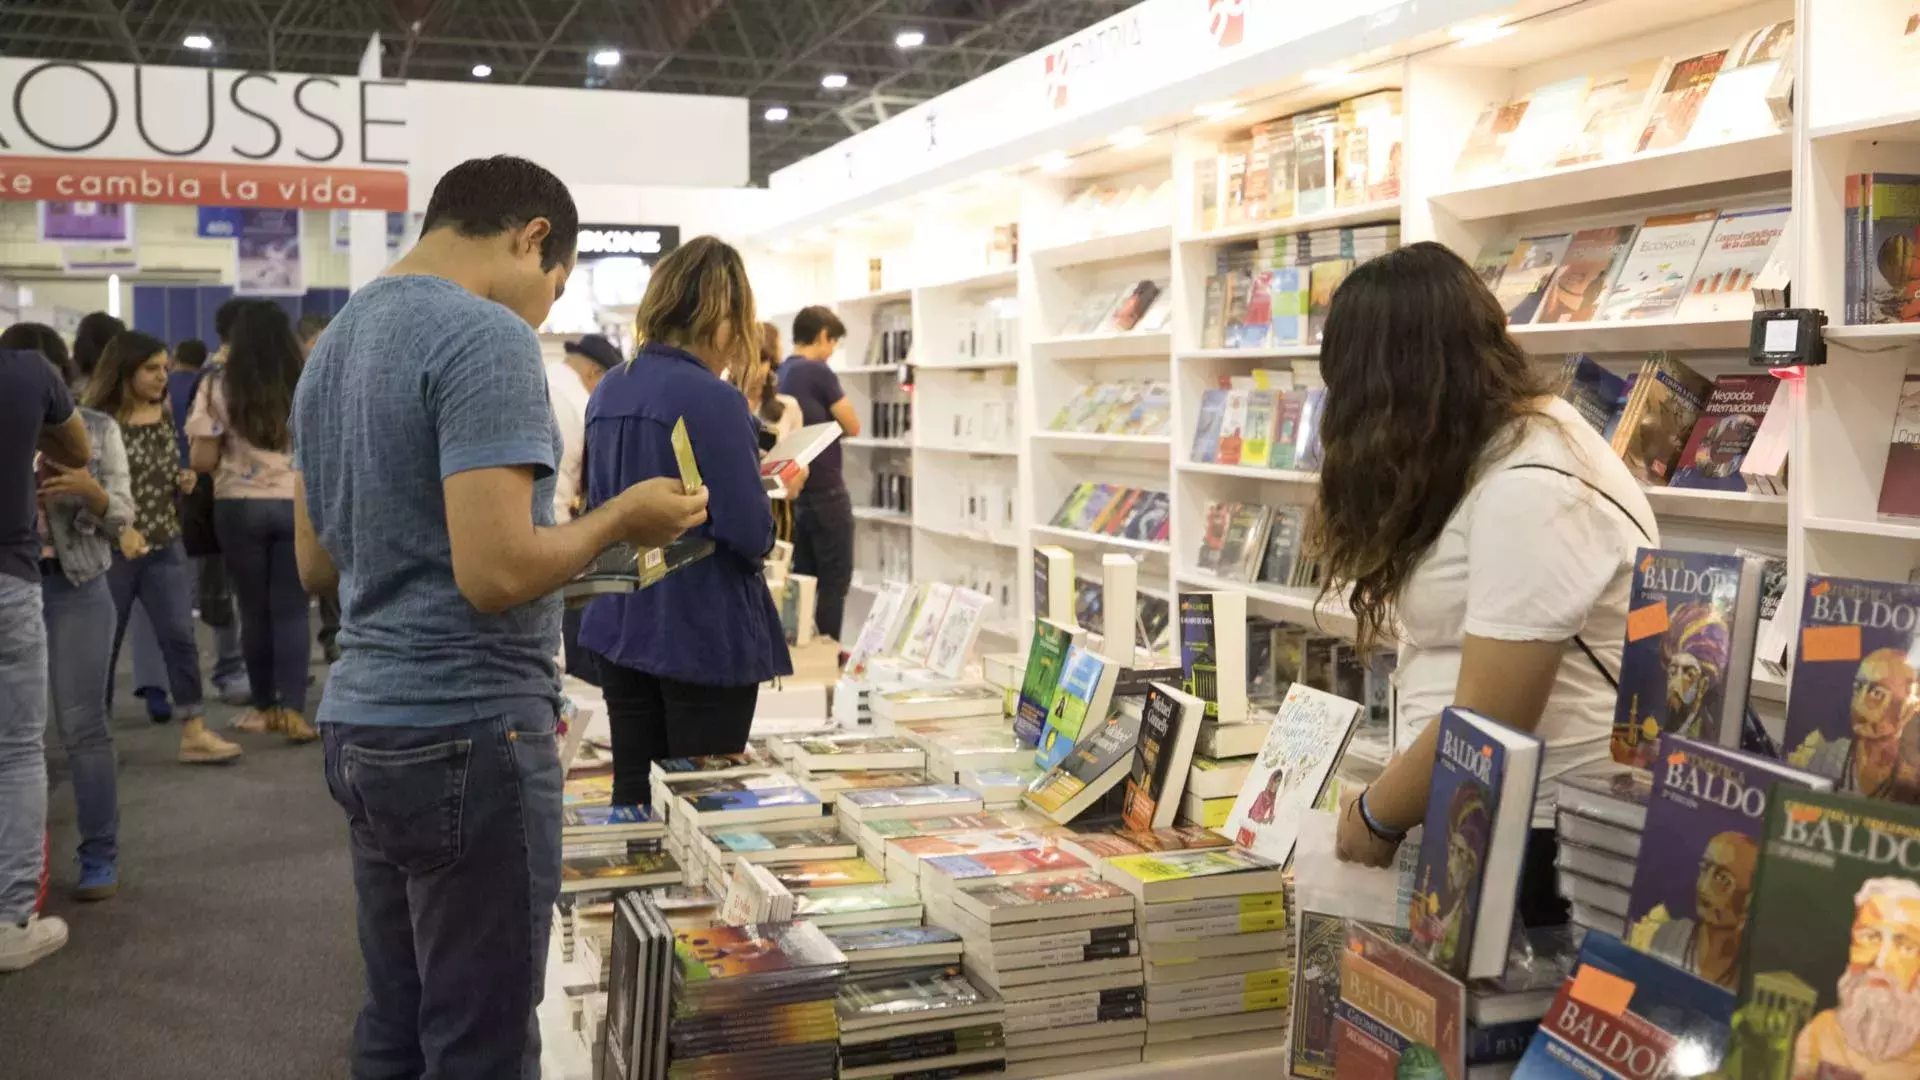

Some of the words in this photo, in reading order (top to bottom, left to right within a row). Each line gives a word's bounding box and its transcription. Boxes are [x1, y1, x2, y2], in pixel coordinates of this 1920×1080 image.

[0, 61, 409, 165] OUSSE
[56, 169, 200, 198] cambia
[220, 170, 258, 200] la
[1711, 390, 1756, 403] Negocios
[1442, 728, 1493, 786] BALDOR
[1664, 759, 1765, 818] BALDO
[1350, 970, 1430, 1041] BALDOR
